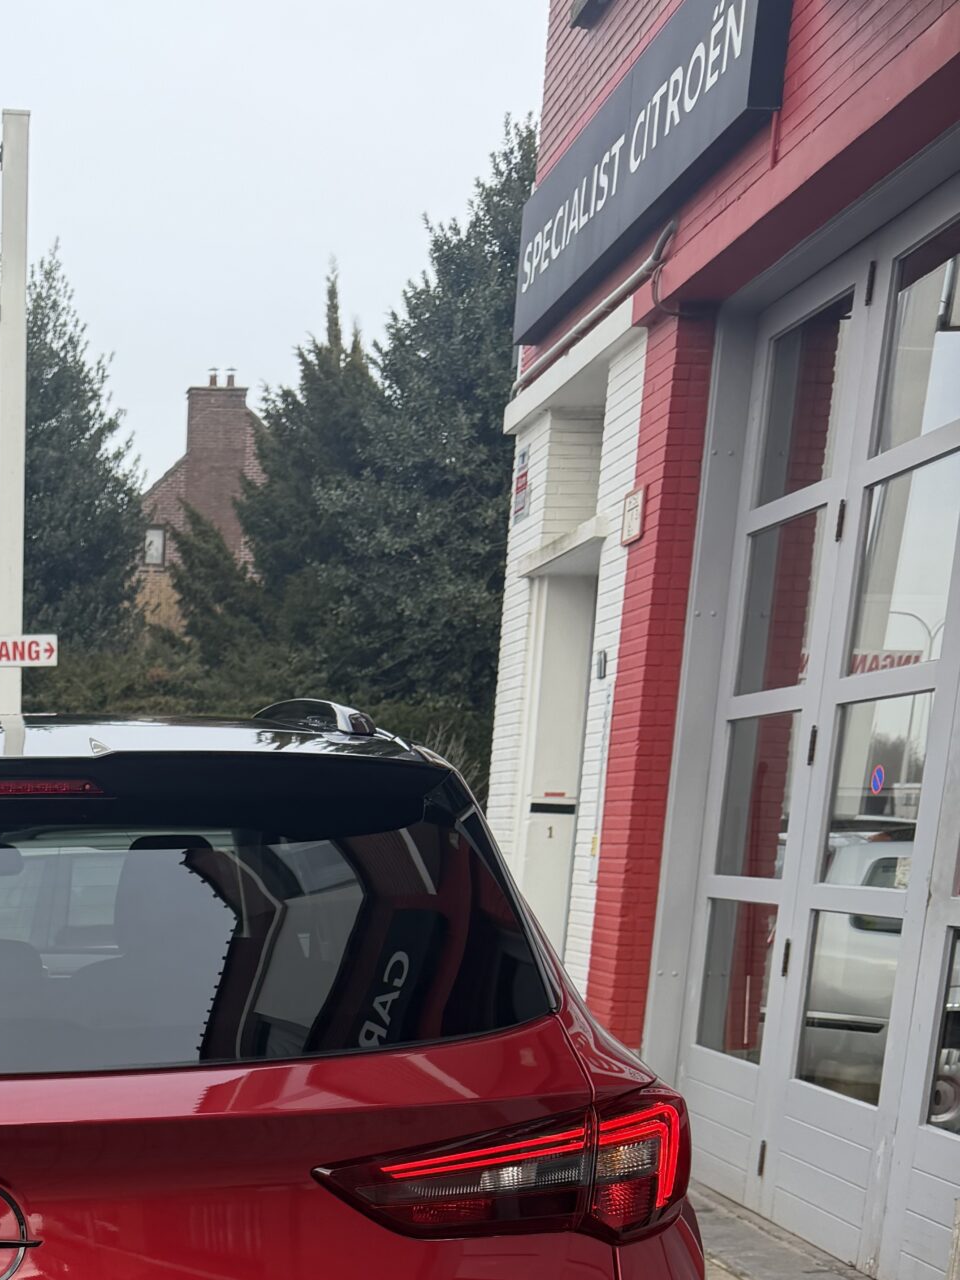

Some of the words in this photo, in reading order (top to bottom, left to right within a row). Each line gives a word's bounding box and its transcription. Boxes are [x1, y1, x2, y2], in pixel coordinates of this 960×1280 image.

[521, 133, 625, 293] SPECIALIST
[629, 0, 747, 173] CITROËN
[547, 826, 553, 839] 1
